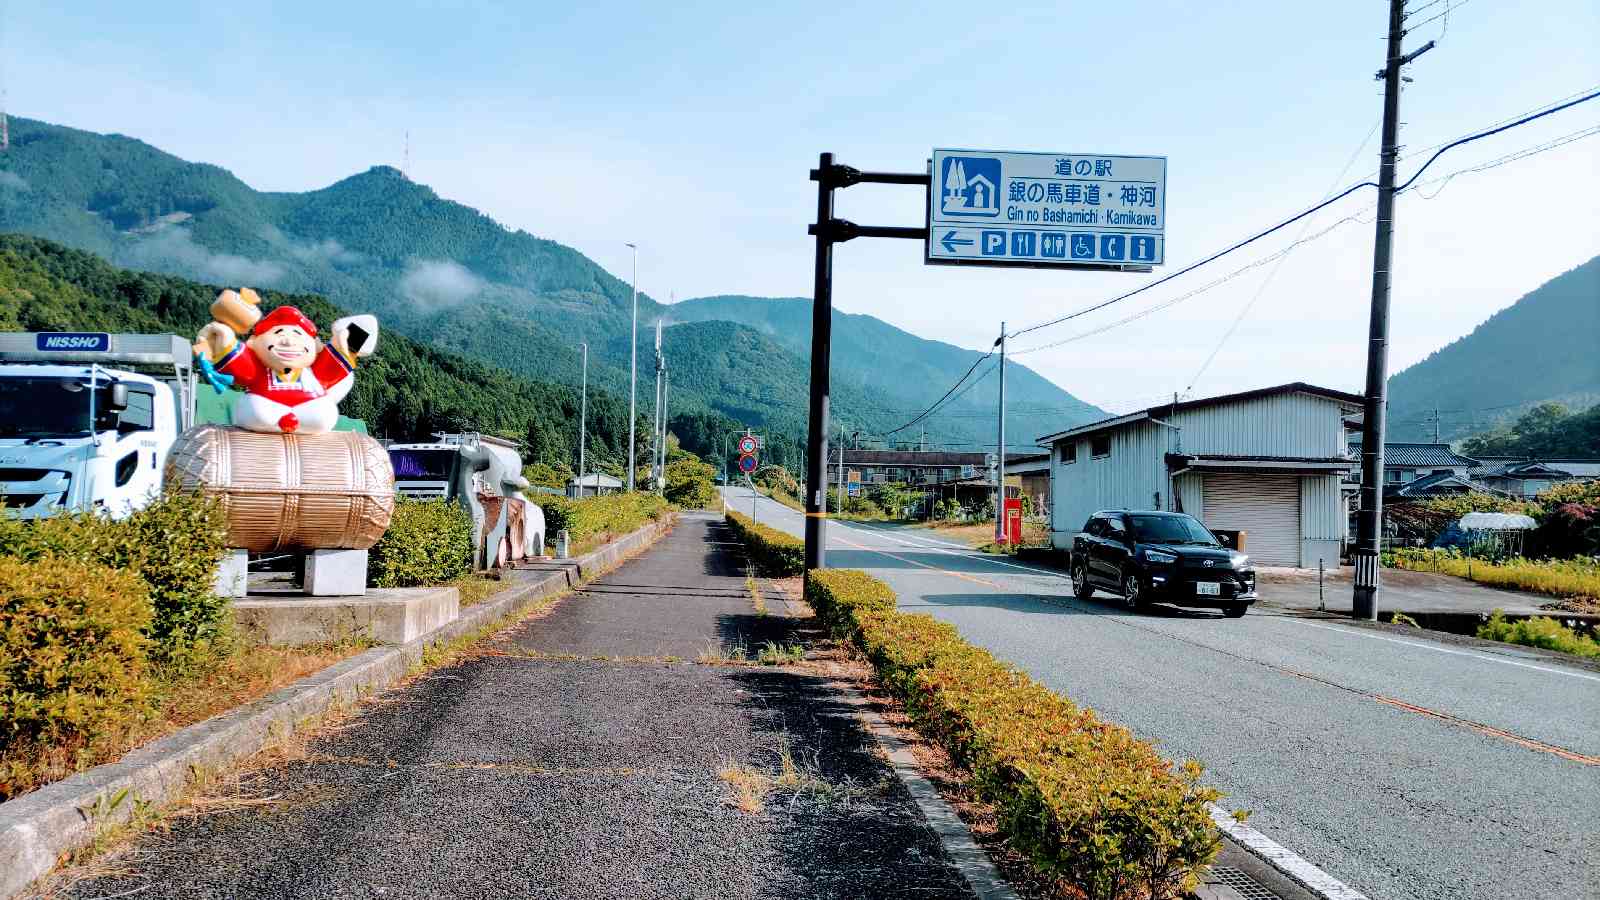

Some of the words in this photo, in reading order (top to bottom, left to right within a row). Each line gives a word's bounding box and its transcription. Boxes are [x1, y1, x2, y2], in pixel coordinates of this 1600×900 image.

[1055, 159, 1112, 177] 道の駅
[1008, 182, 1157, 207] 銀の馬車道・神河
[1007, 207, 1024, 221] Gin
[1026, 210, 1039, 222] no
[1043, 208, 1098, 224] Bashamichi
[1106, 209, 1157, 226] Kamikawa
[46, 336, 100, 348] NISSHO
